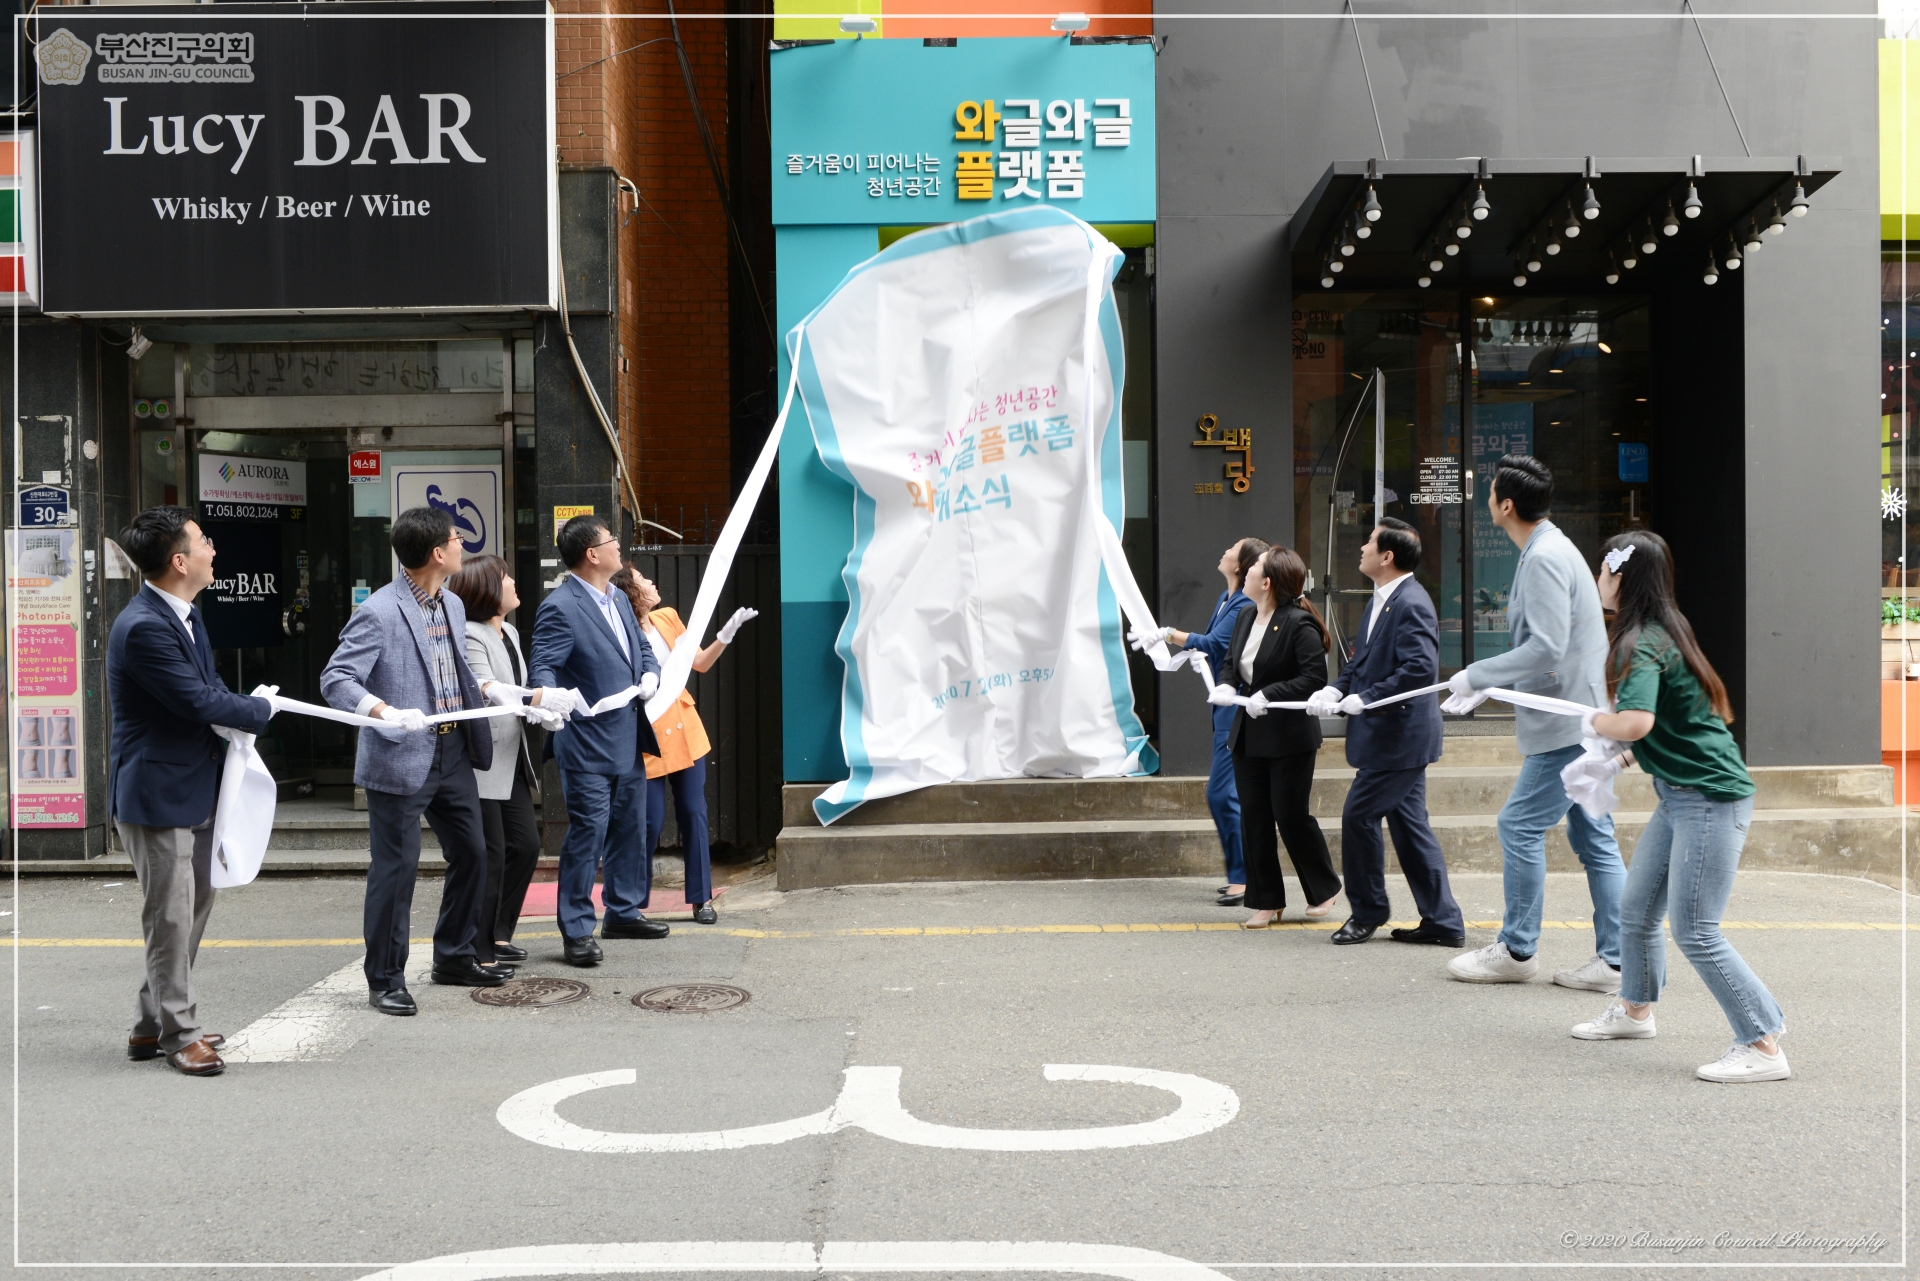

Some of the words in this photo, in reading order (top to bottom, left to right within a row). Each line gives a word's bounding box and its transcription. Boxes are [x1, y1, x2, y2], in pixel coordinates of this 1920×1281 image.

[955, 98, 1133, 147] 와글와글
[103, 96, 265, 175] Lucy
[293, 92, 487, 166] BAR
[786, 154, 860, 174] 즐거움이
[866, 153, 941, 174] 피어나는
[955, 150, 1087, 200] 플랫폼
[867, 177, 941, 197] 청년공간
[152, 197, 252, 225] Whisky
[259, 196, 268, 218] /
[276, 195, 337, 218] Beer
[344, 195, 354, 217] /
[360, 194, 431, 217] Wine
[1309, 310, 1330, 320] CCTV
[1309, 342, 1325, 354] NO
[995, 384, 1058, 416] 청년공간
[238, 464, 289, 480] AURORA
[353, 459, 376, 468] 에스원
[34, 507, 55, 522] 30
[206, 504, 278, 519] T.051.802.1264
[290, 508, 302, 519] 3F
[557, 508, 577, 516] CCTV
[237, 573, 277, 594] BAR
